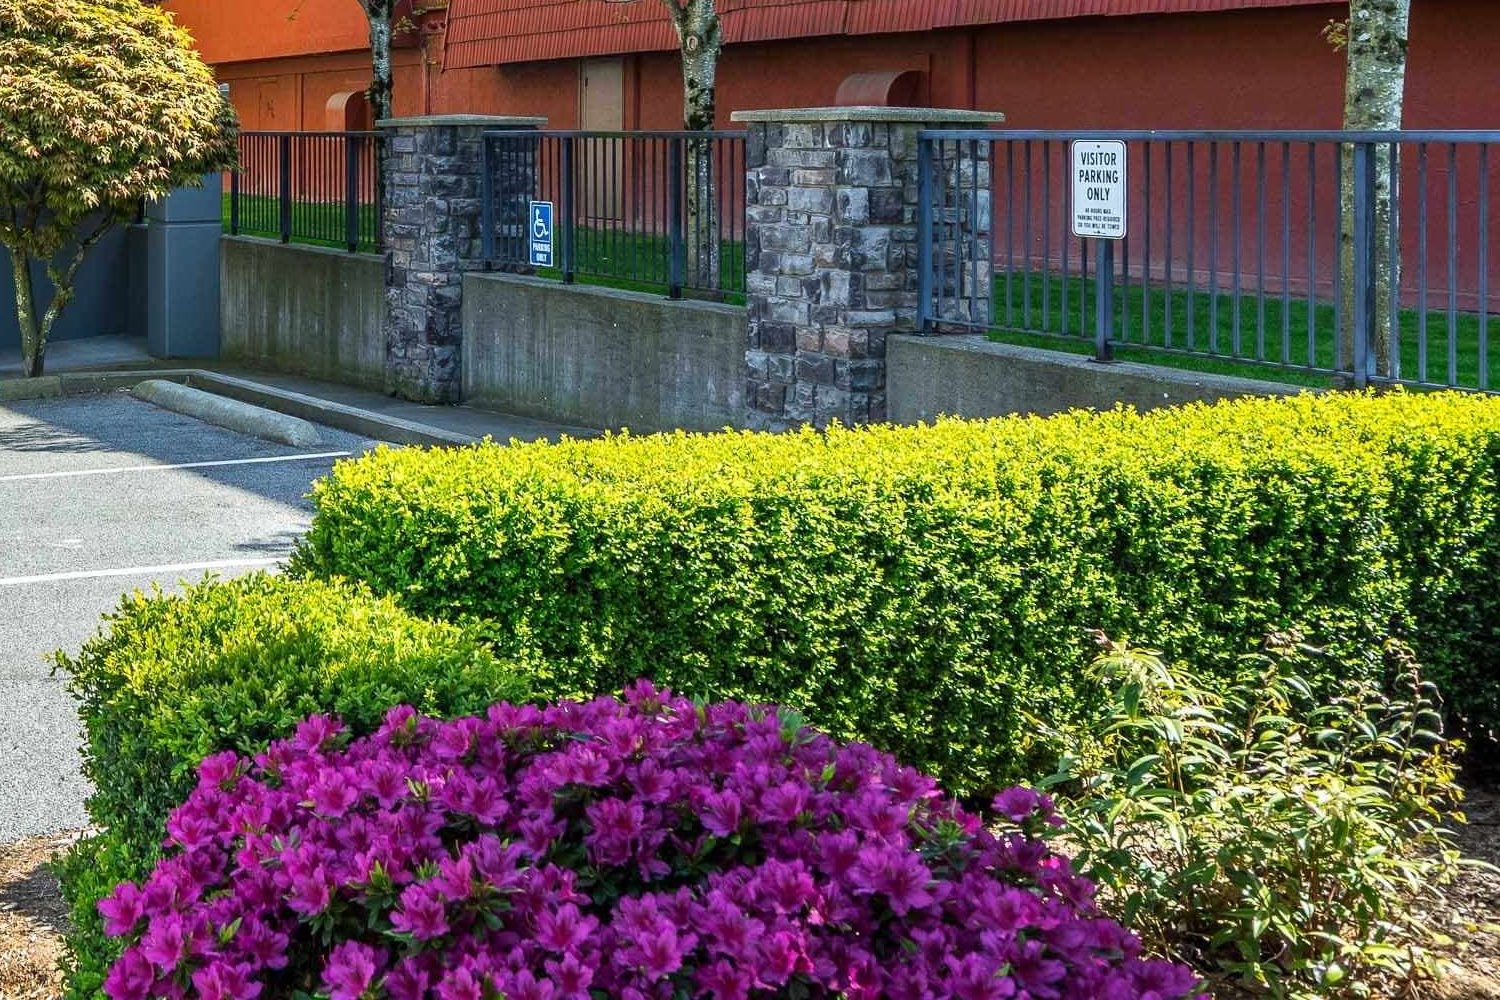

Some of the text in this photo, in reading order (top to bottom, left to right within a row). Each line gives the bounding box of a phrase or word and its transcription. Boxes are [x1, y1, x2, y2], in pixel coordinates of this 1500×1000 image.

[1081, 152, 1117, 166] VISITOR
[1079, 169, 1119, 184] PARKING
[1086, 187, 1110, 201] ONLY
